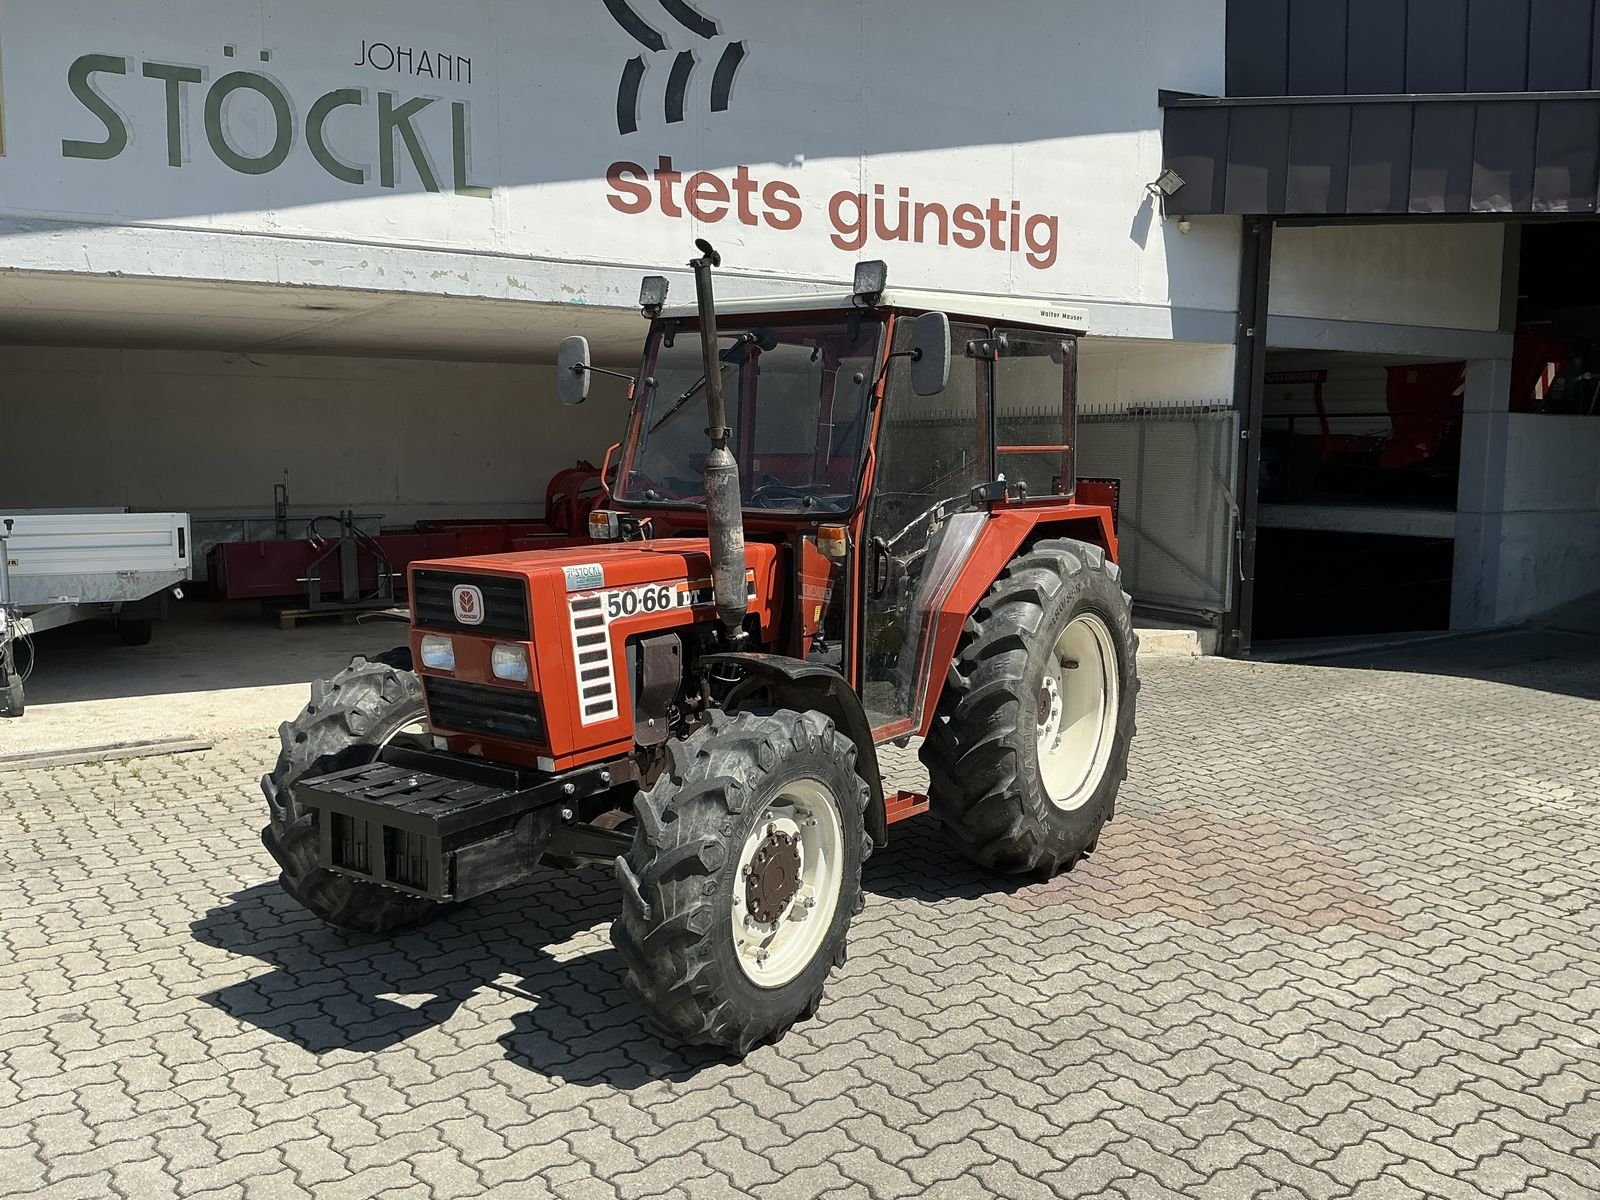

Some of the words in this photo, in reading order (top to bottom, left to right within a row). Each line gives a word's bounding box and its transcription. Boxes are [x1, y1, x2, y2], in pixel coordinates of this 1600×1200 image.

[354, 39, 472, 85] JOHANN
[61, 44, 493, 199] STÖCKL
[605, 154, 803, 231] stets
[827, 183, 1059, 271] günstig
[1040, 310, 1060, 319] Walter
